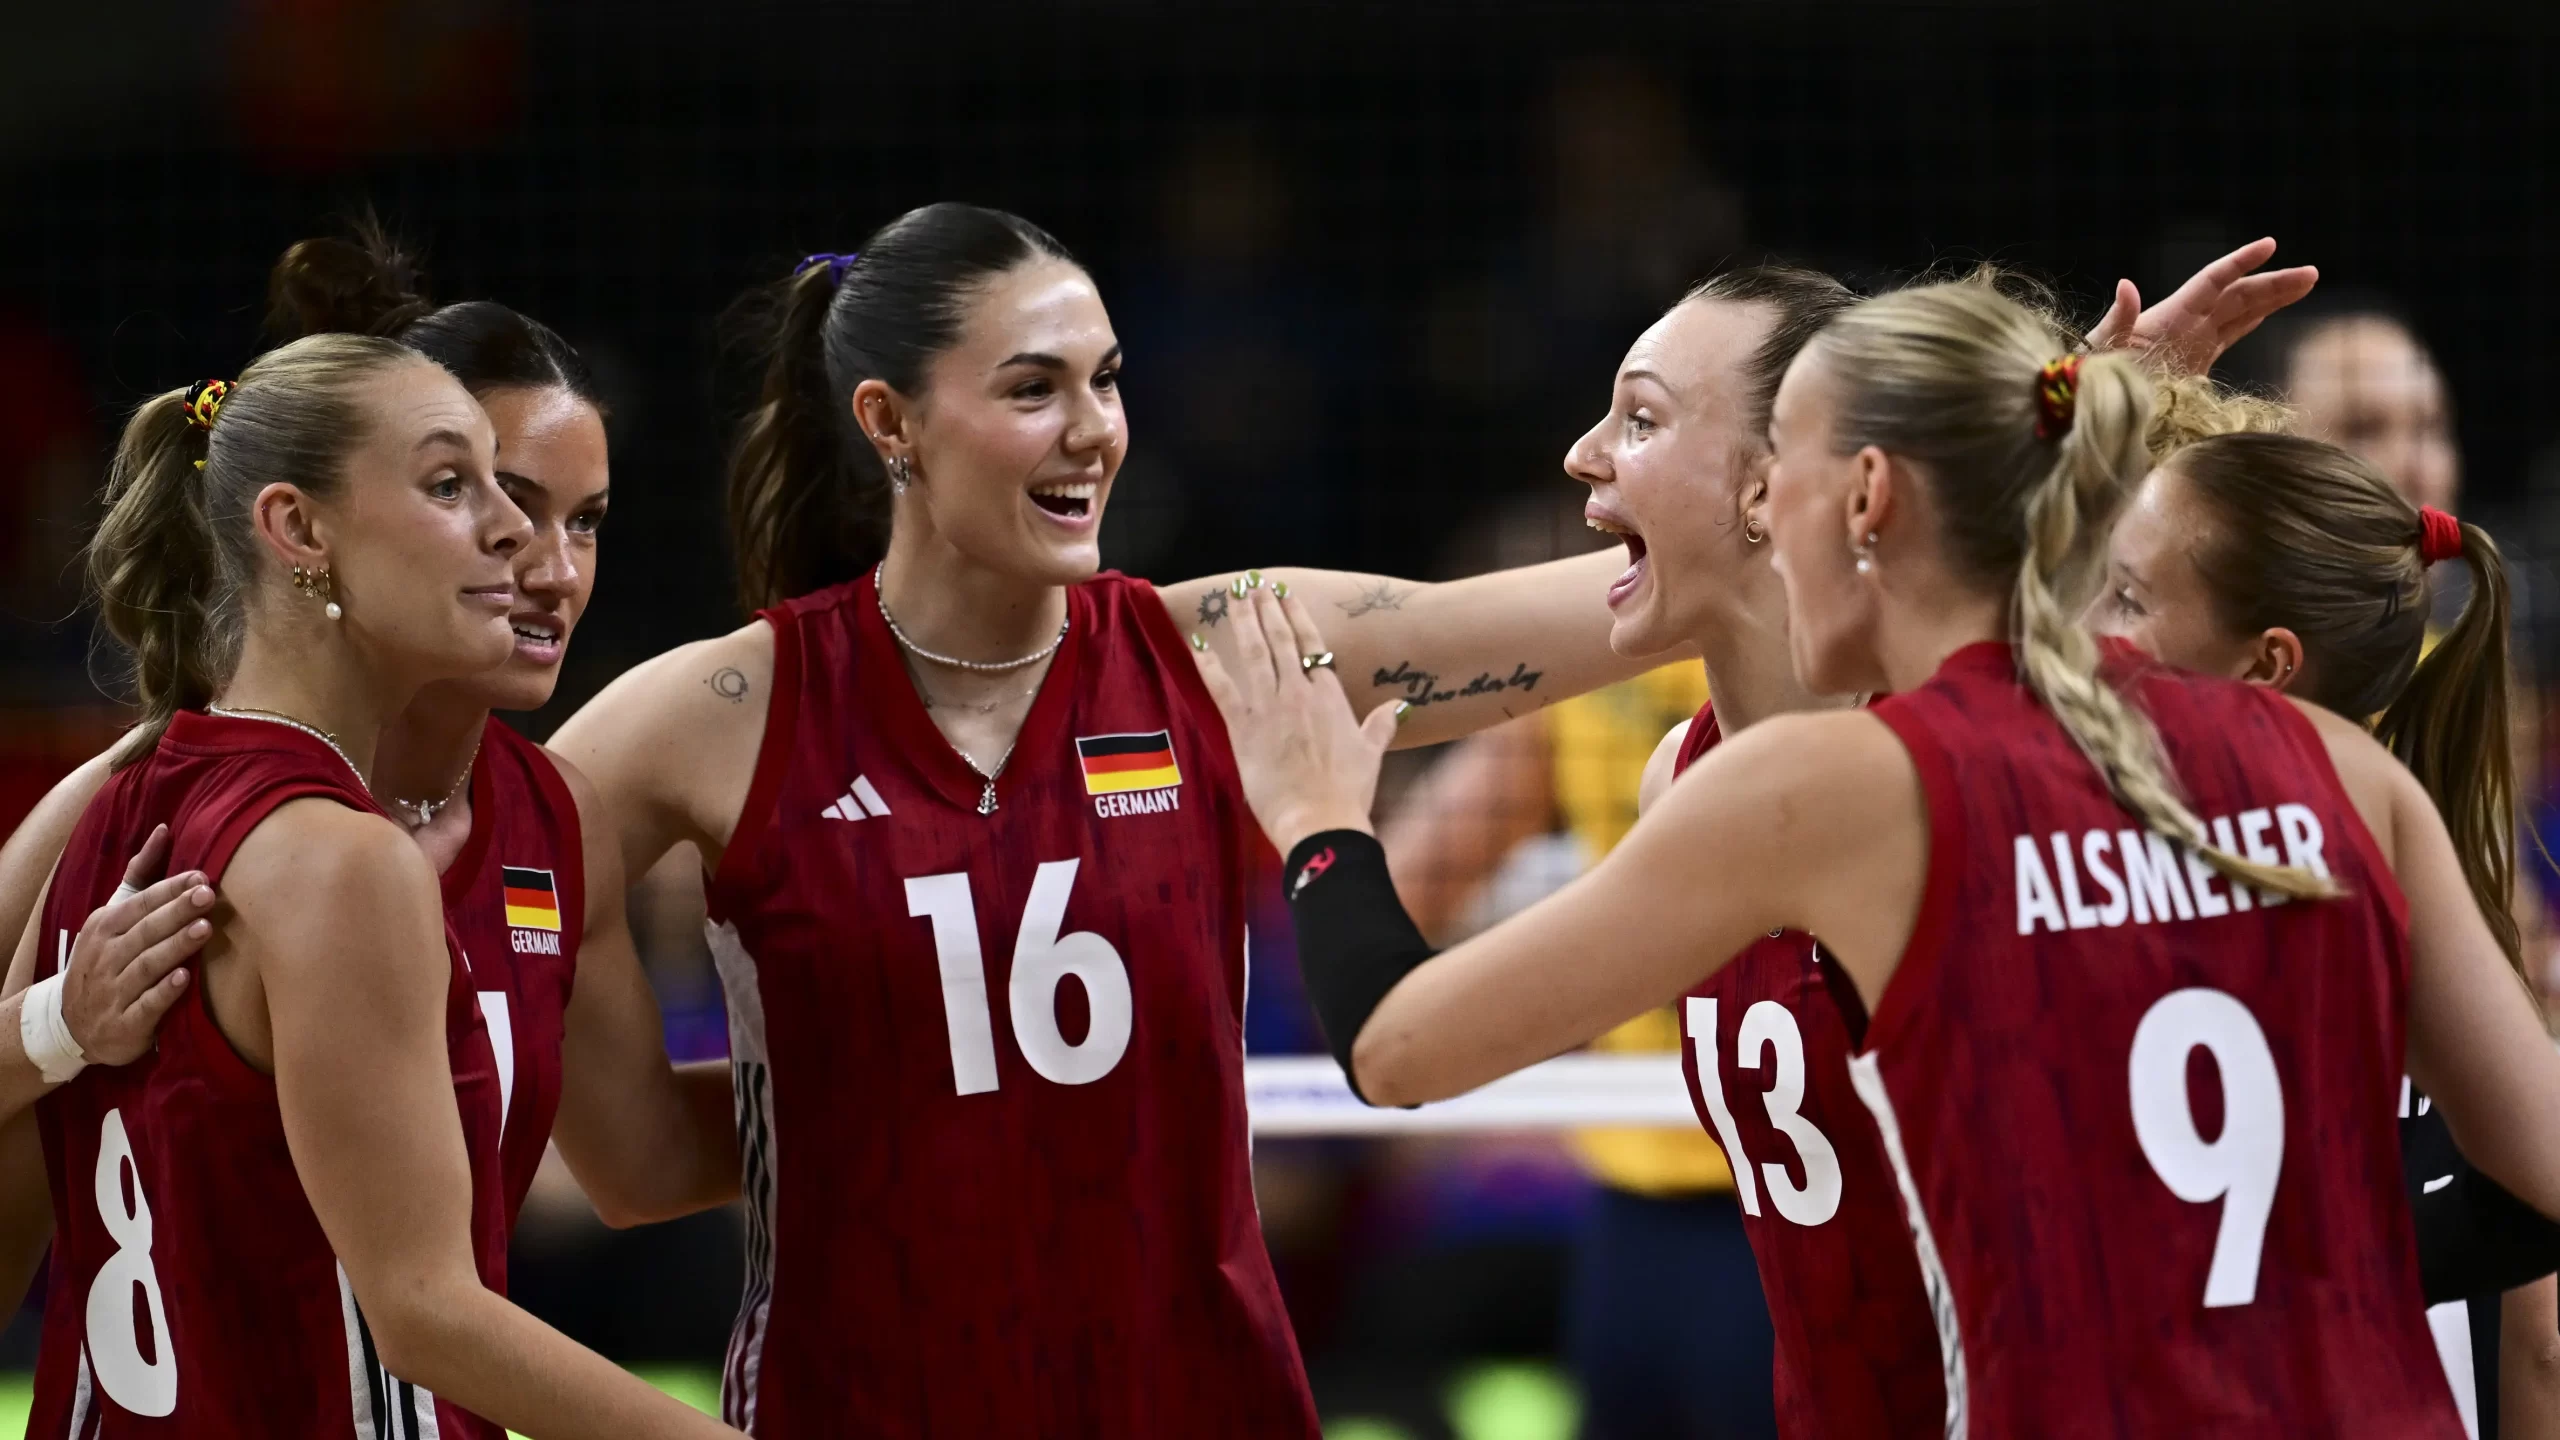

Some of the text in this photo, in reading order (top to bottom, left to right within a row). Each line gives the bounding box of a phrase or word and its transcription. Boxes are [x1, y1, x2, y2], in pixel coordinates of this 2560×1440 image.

[1095, 788, 1179, 818] GERMANY
[2014, 803, 2335, 936] ALSMEIER
[511, 931, 561, 956] GERMANY
[903, 857, 1133, 1097] 16
[1686, 996, 1843, 1226] 13
[2128, 986, 2285, 1308] 9
[86, 1107, 178, 1418] 8
